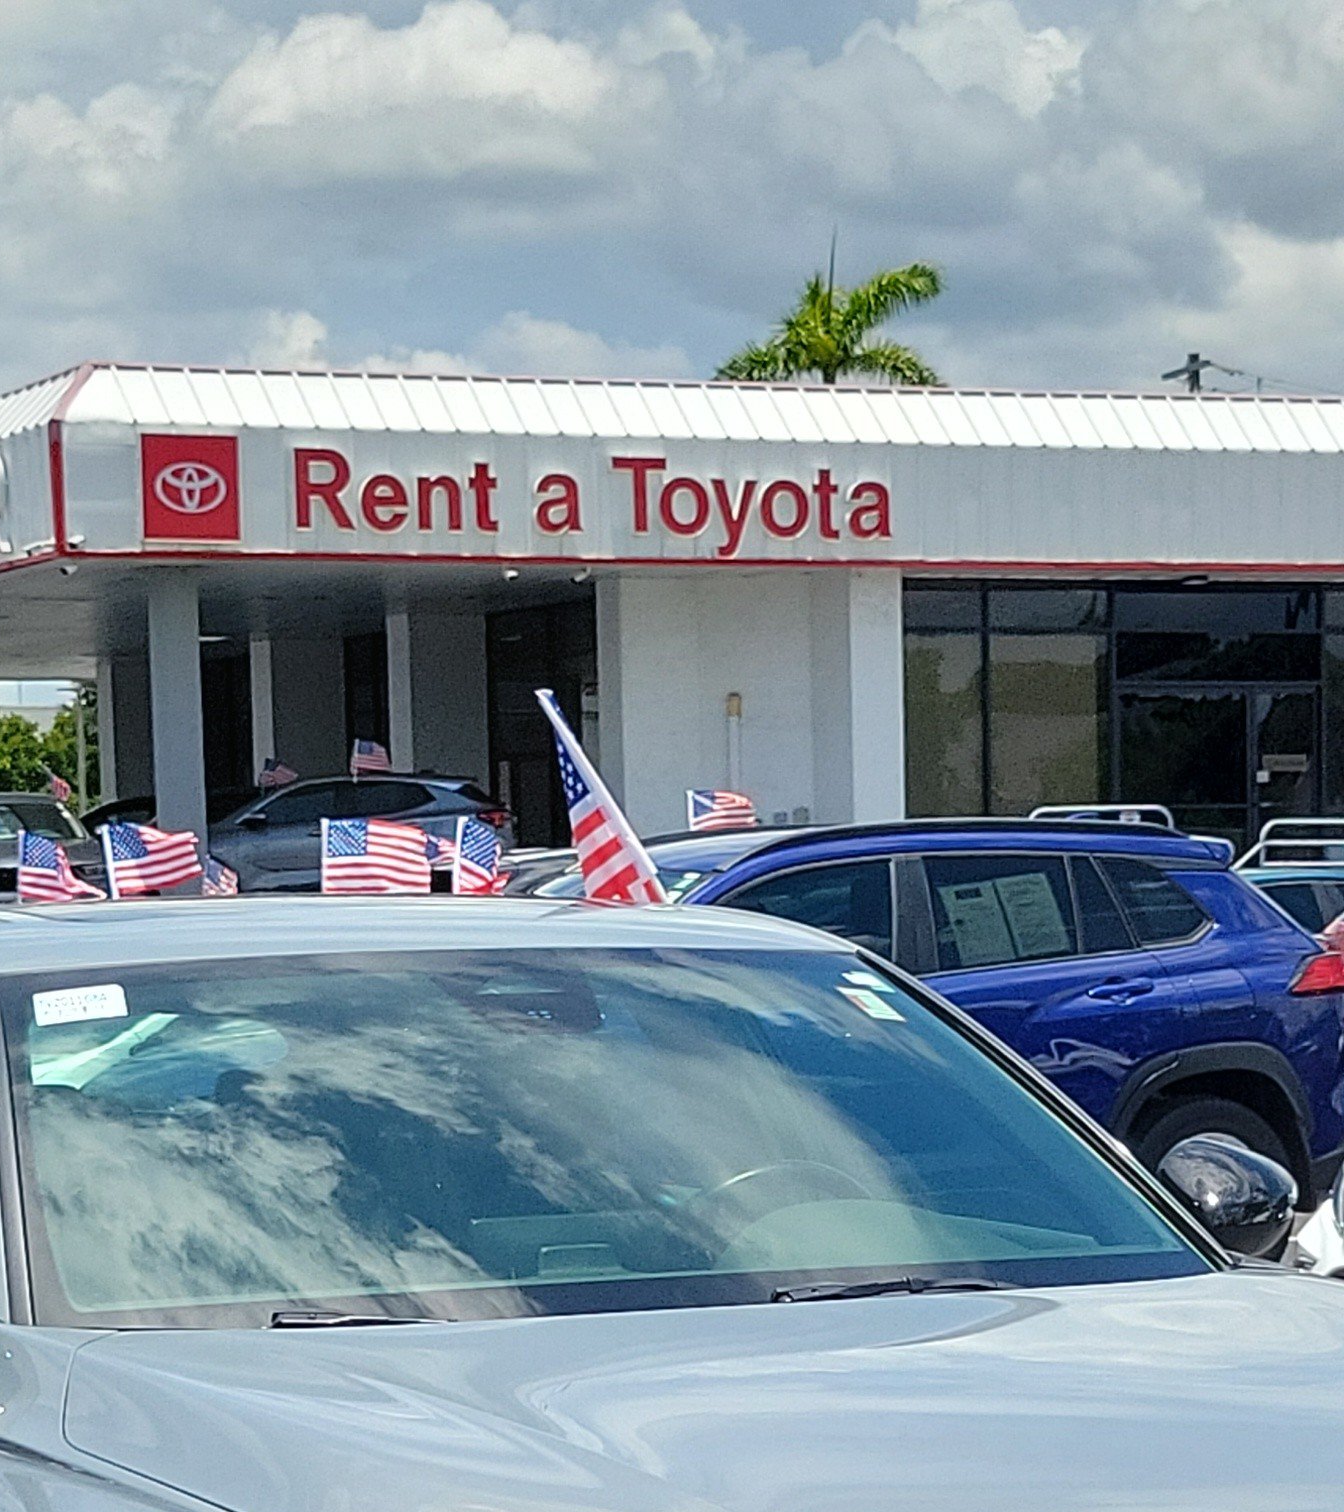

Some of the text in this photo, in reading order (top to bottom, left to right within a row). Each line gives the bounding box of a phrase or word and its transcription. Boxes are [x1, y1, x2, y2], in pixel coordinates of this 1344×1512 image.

[293, 447, 892, 557] Rent a Toyota
